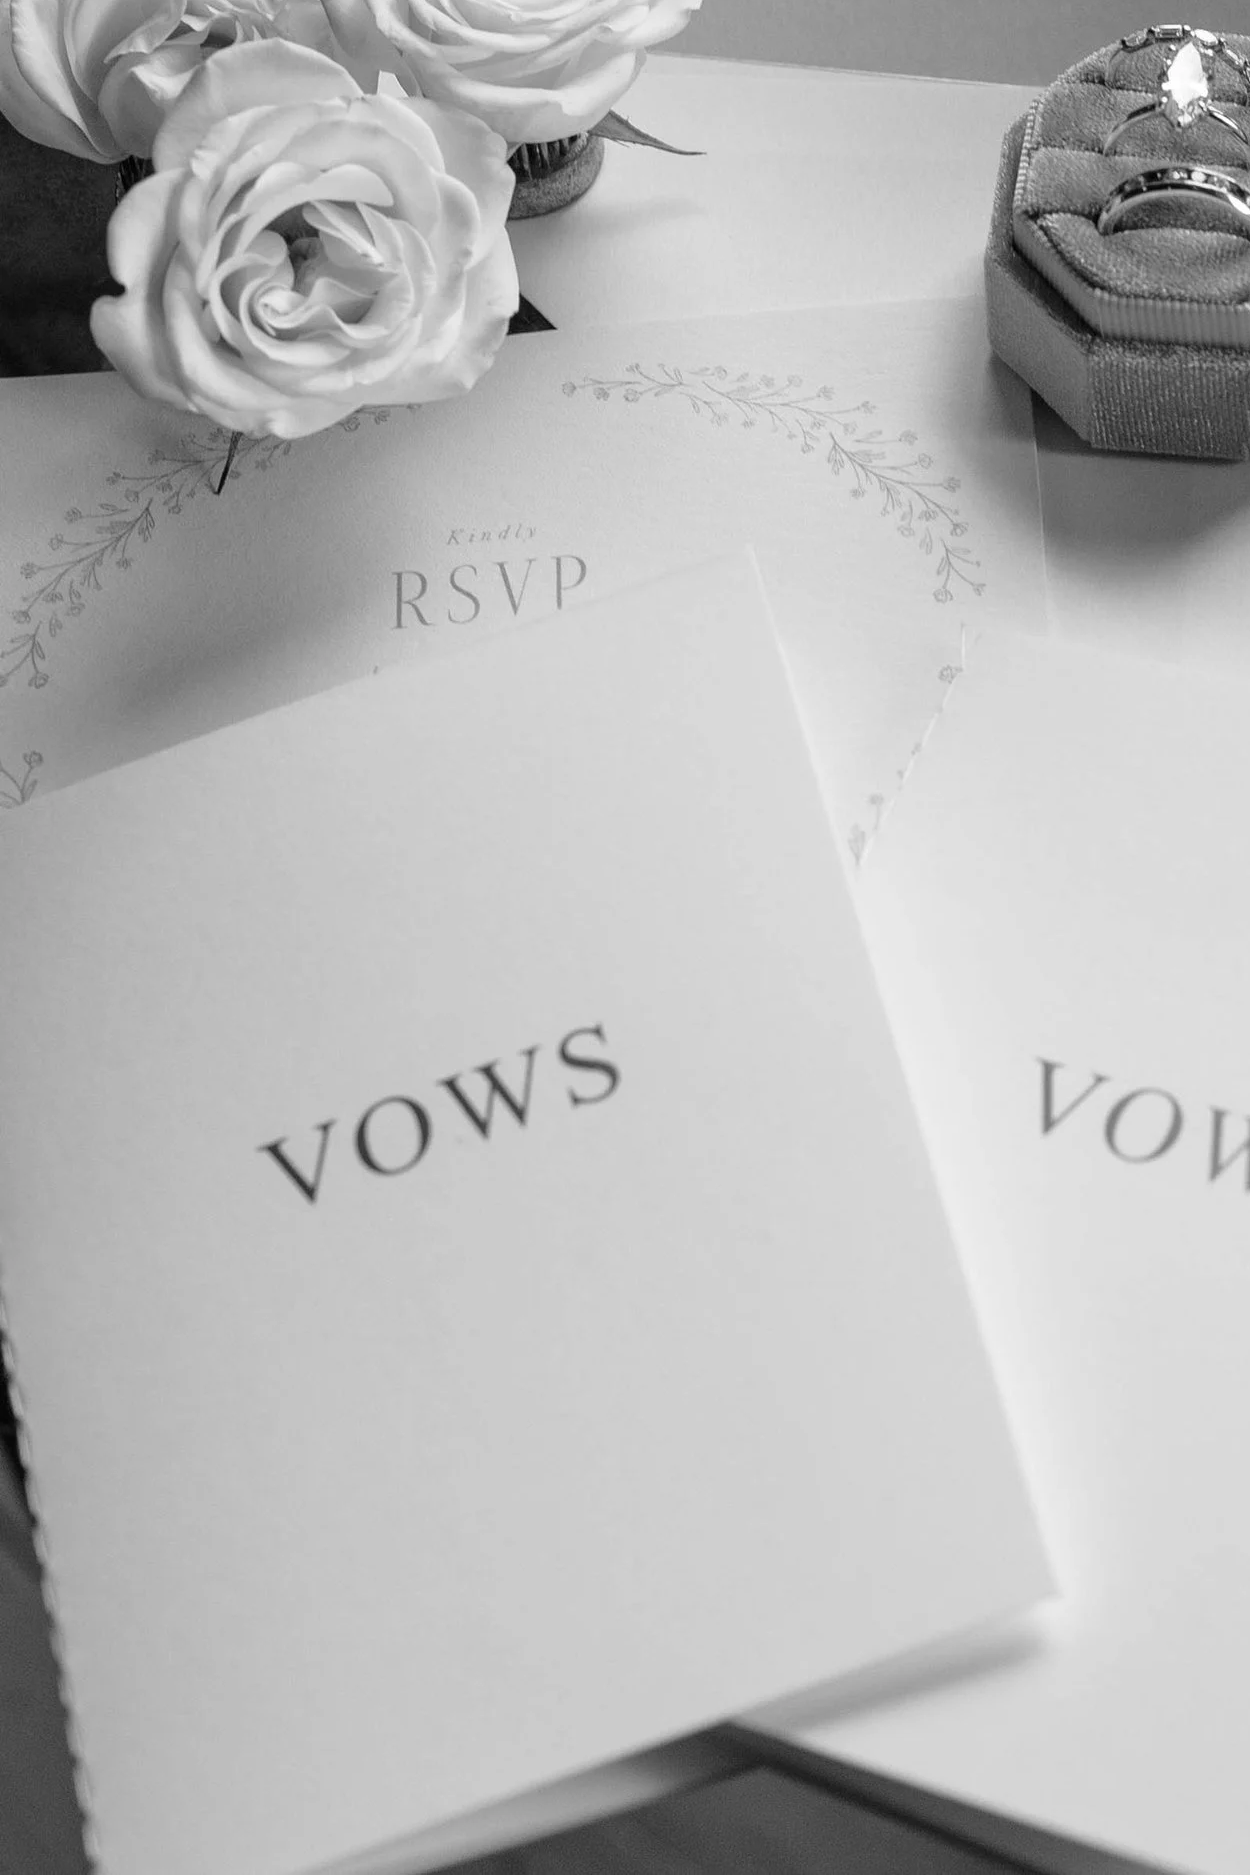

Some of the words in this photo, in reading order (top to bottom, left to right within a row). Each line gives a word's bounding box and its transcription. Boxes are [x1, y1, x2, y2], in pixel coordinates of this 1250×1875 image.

[446, 522, 538, 546] Kindly
[391, 553, 588, 631] RSVP
[257, 1022, 623, 1206] VOWS
